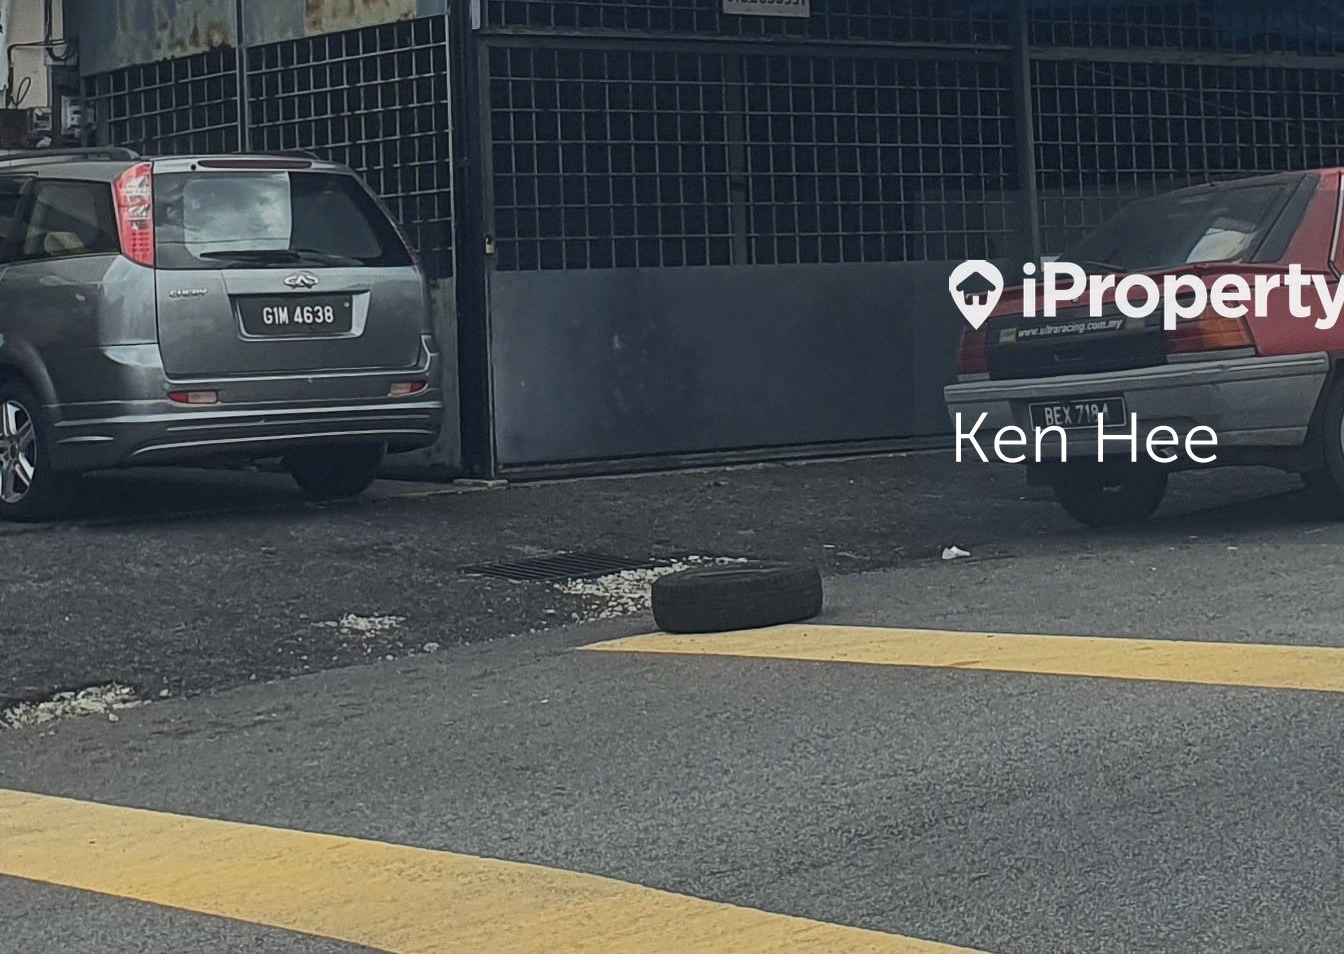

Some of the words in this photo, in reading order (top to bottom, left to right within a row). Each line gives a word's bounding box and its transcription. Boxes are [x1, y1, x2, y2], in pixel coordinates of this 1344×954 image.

[294, 306, 334, 324] 4638
[1018, 319, 1123, 337] www.ultraracing.com.my
[1044, 405, 1072, 426] BEX
